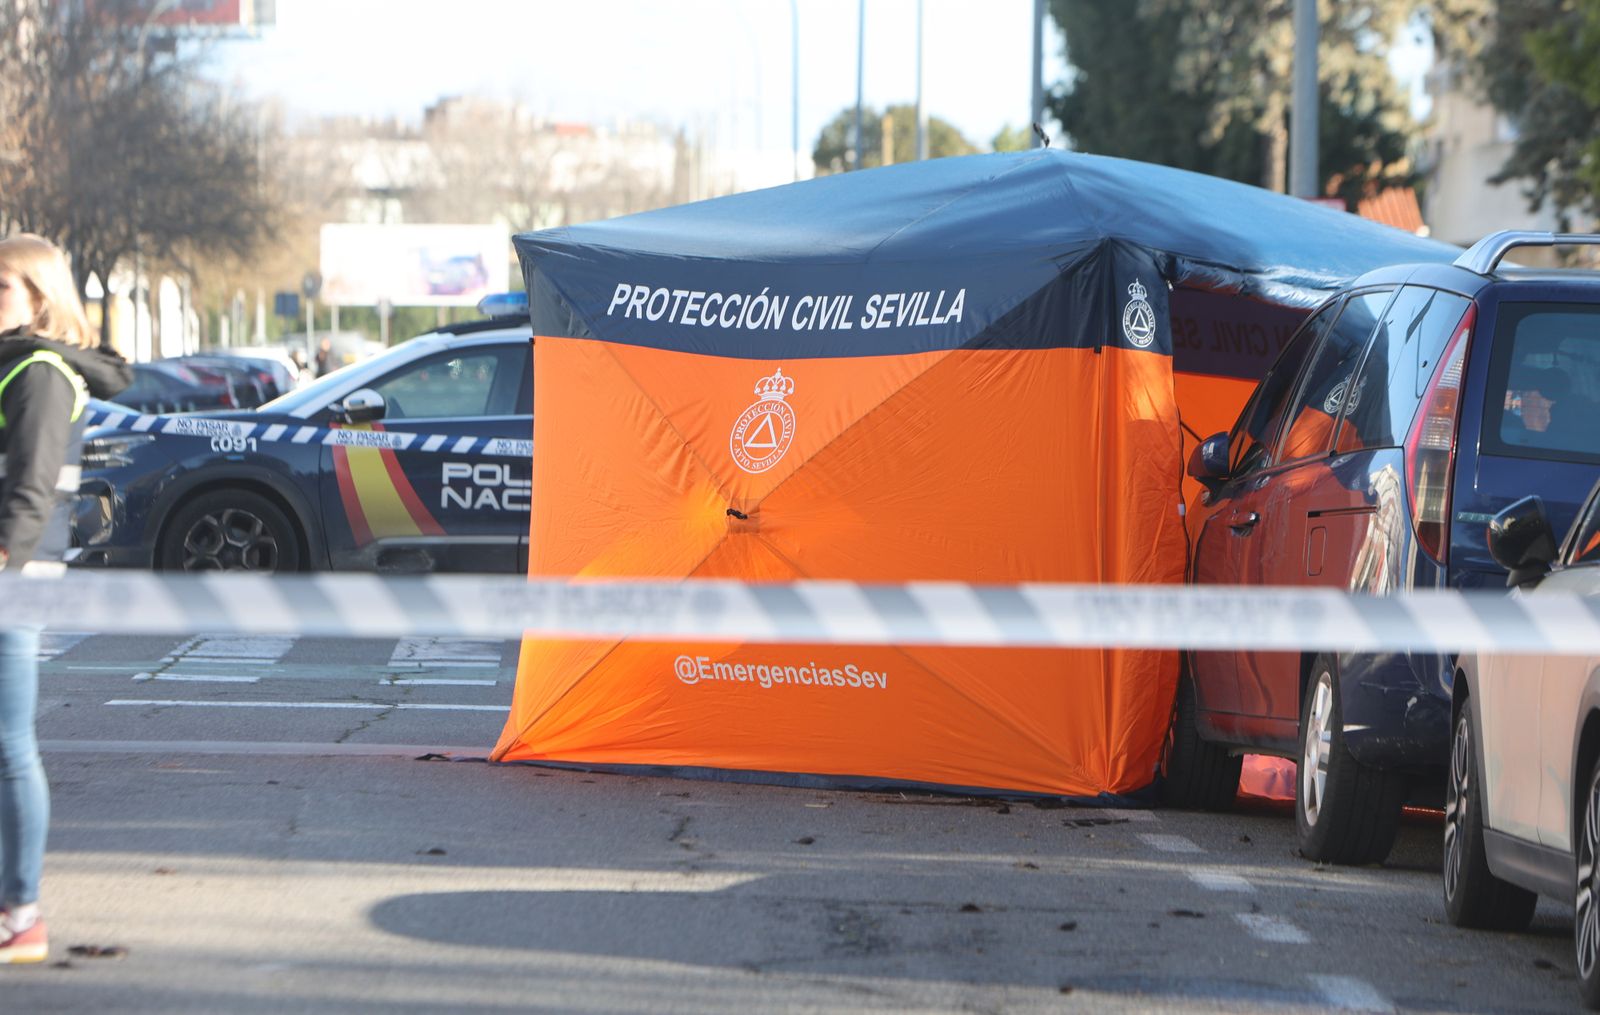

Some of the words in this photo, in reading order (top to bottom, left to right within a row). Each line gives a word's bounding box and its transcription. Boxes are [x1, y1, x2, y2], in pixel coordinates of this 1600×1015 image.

[607, 283, 790, 331] PROTECCIÓN
[791, 295, 853, 331] CIVIL
[860, 288, 966, 330] SEVILLA
[177, 416, 193, 428] NO
[196, 419, 229, 432] PASAR
[337, 430, 353, 440] NO
[356, 432, 389, 443] PASAR
[782, 413, 792, 439] CIVIL
[497, 439, 512, 449] NO
[751, 449, 783, 470] SEVILLA
[442, 462, 532, 487] POL
[441, 486, 531, 511] NAC
[674, 655, 888, 689] @EmergenciasSev
